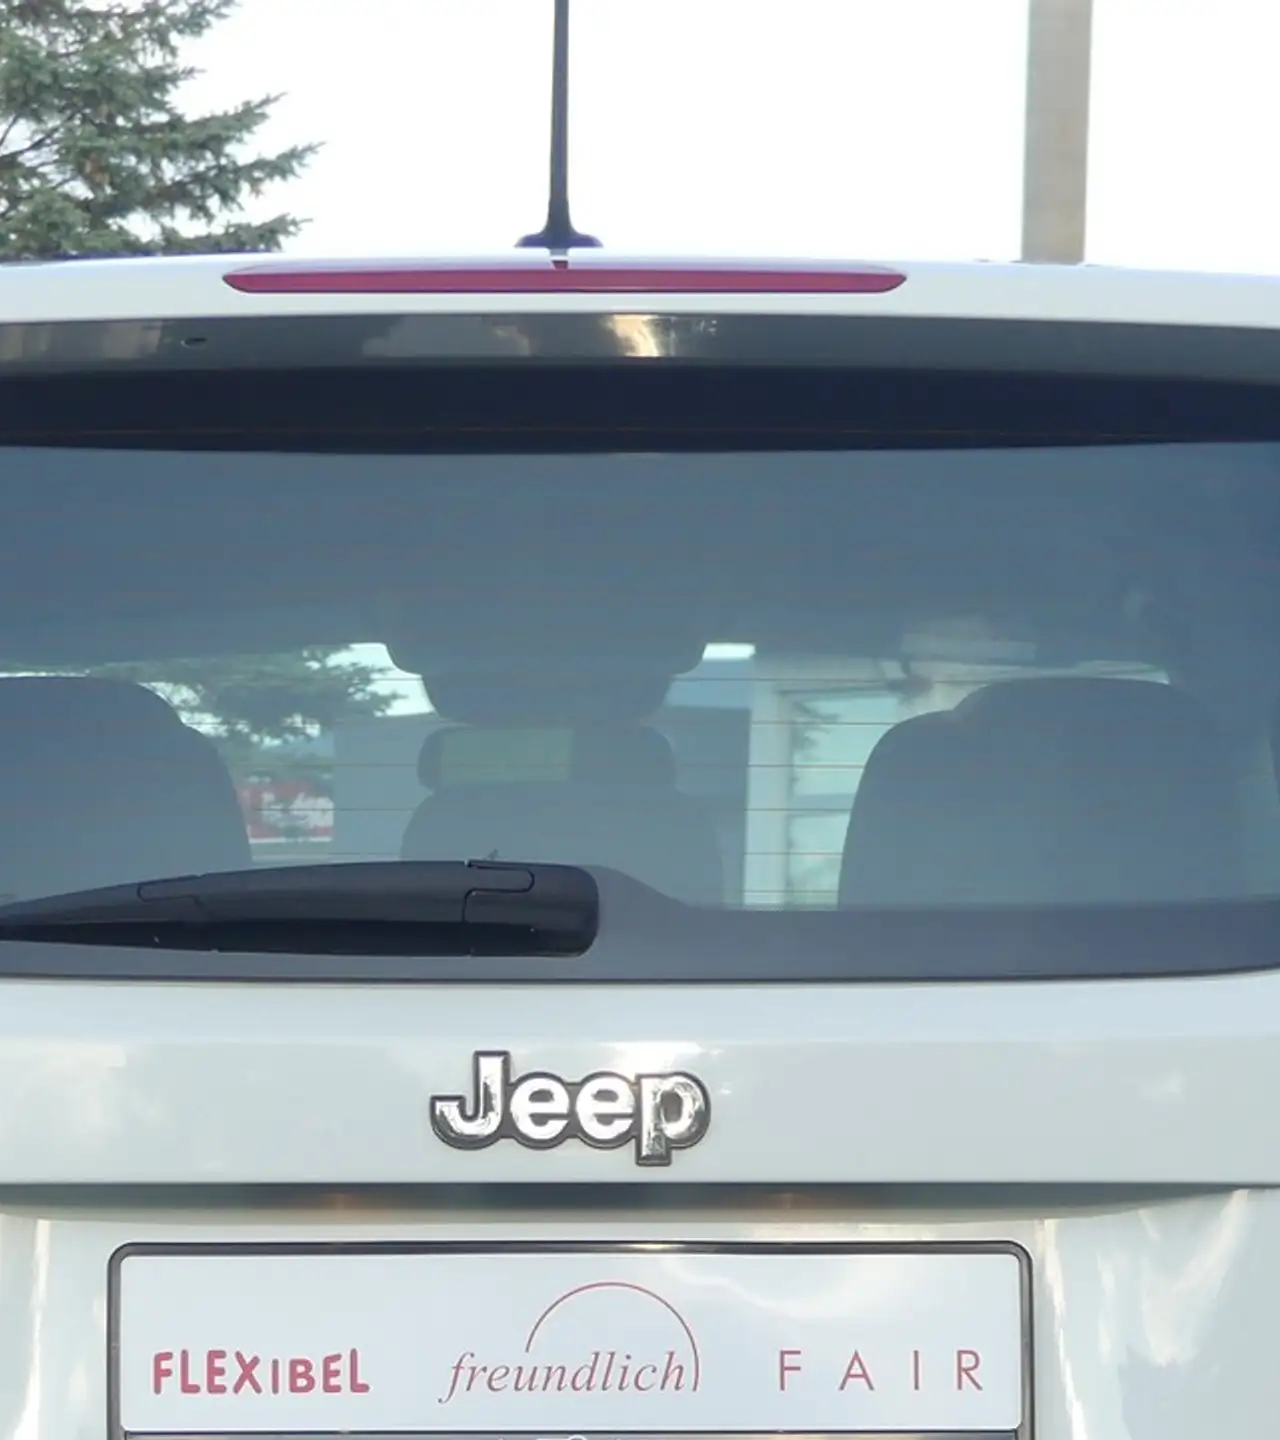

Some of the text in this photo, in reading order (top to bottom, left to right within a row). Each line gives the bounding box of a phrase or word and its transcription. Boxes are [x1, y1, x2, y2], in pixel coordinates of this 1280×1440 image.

[429, 1050, 712, 1167] Jeep
[152, 1347, 983, 1404] FLEXIBEL freundlich FAIR
